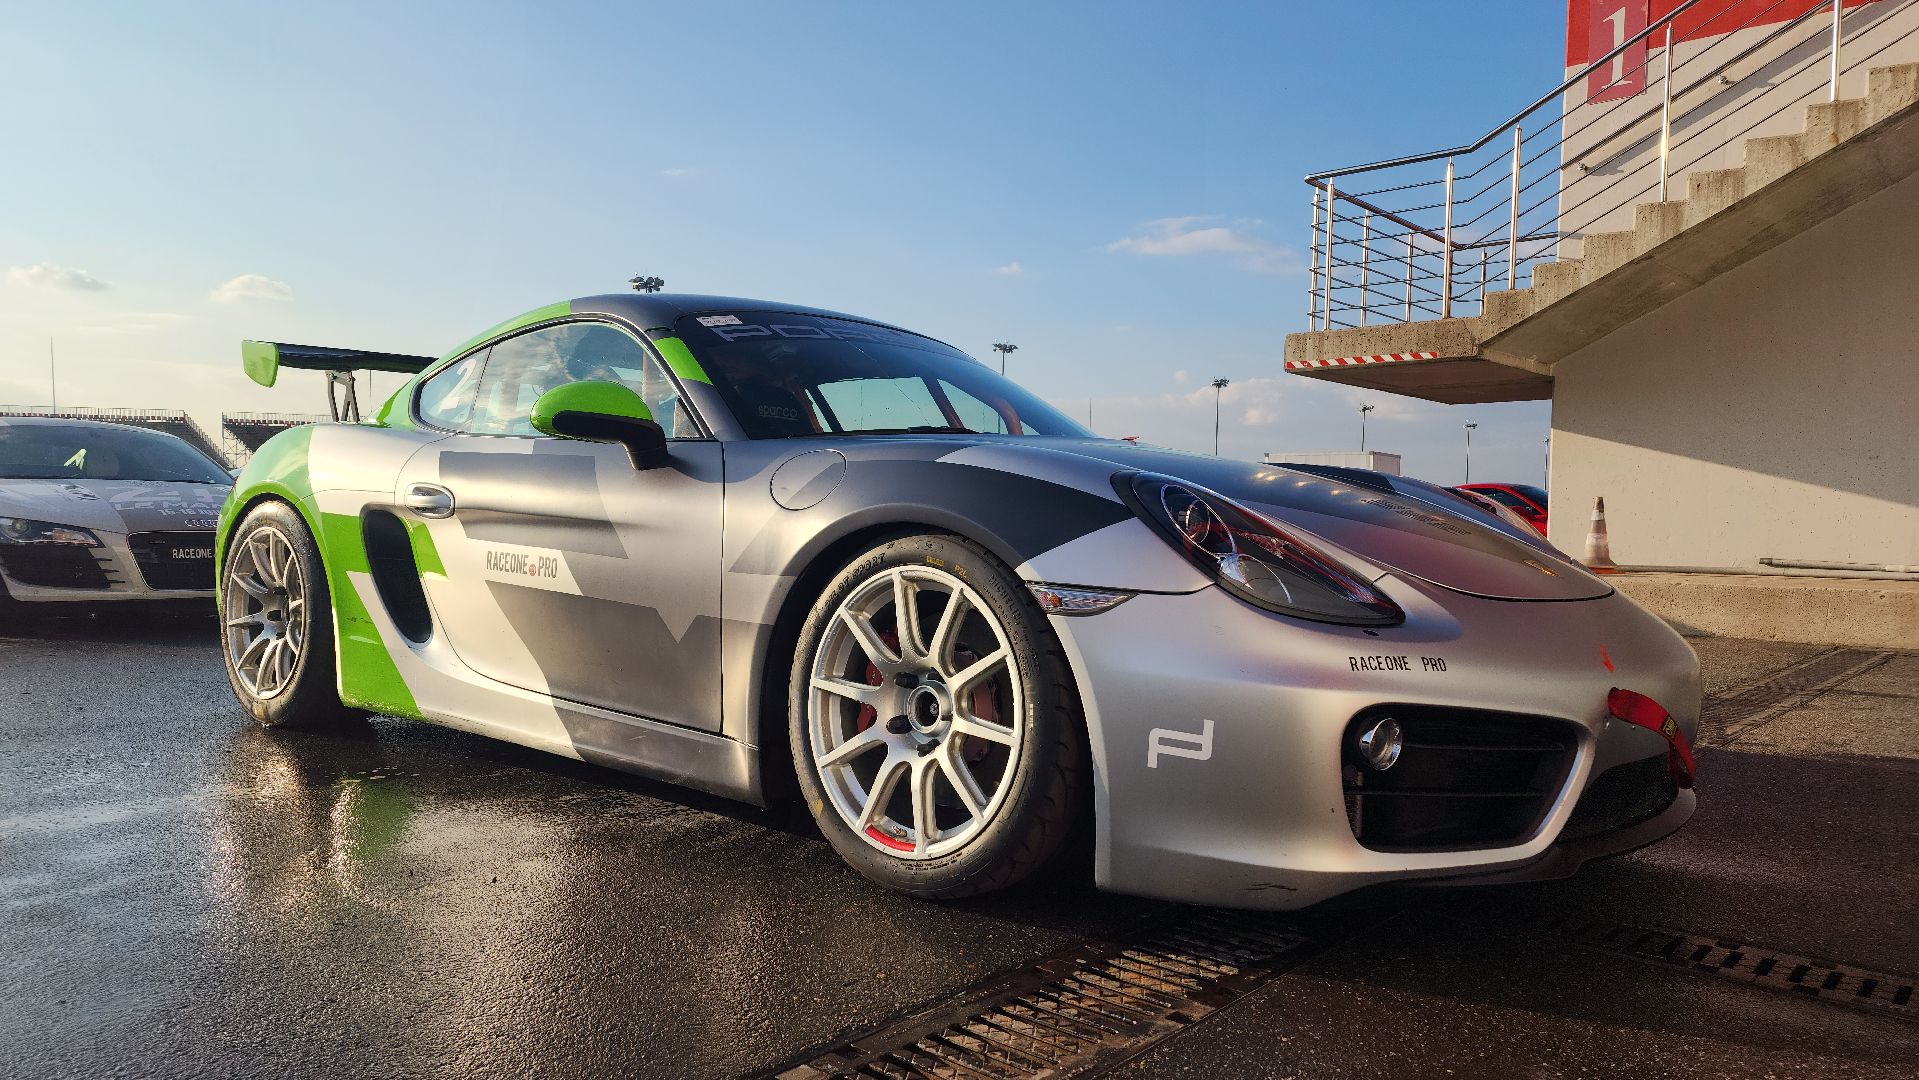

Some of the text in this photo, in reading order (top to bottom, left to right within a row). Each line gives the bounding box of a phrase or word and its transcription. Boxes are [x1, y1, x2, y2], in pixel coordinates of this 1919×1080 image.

[1602, 6, 1633, 88] 1
[439, 358, 477, 410] 2
[758, 405, 798, 418] sparco
[172, 548, 213, 559] RACEONE
[486, 550, 529, 575] RACEONE
[537, 555, 558, 579] PRO
[852, 552, 886, 581] SPORT
[989, 574, 1023, 626] MICHELIN
[1348, 655, 1447, 672] RACEONE PRO
